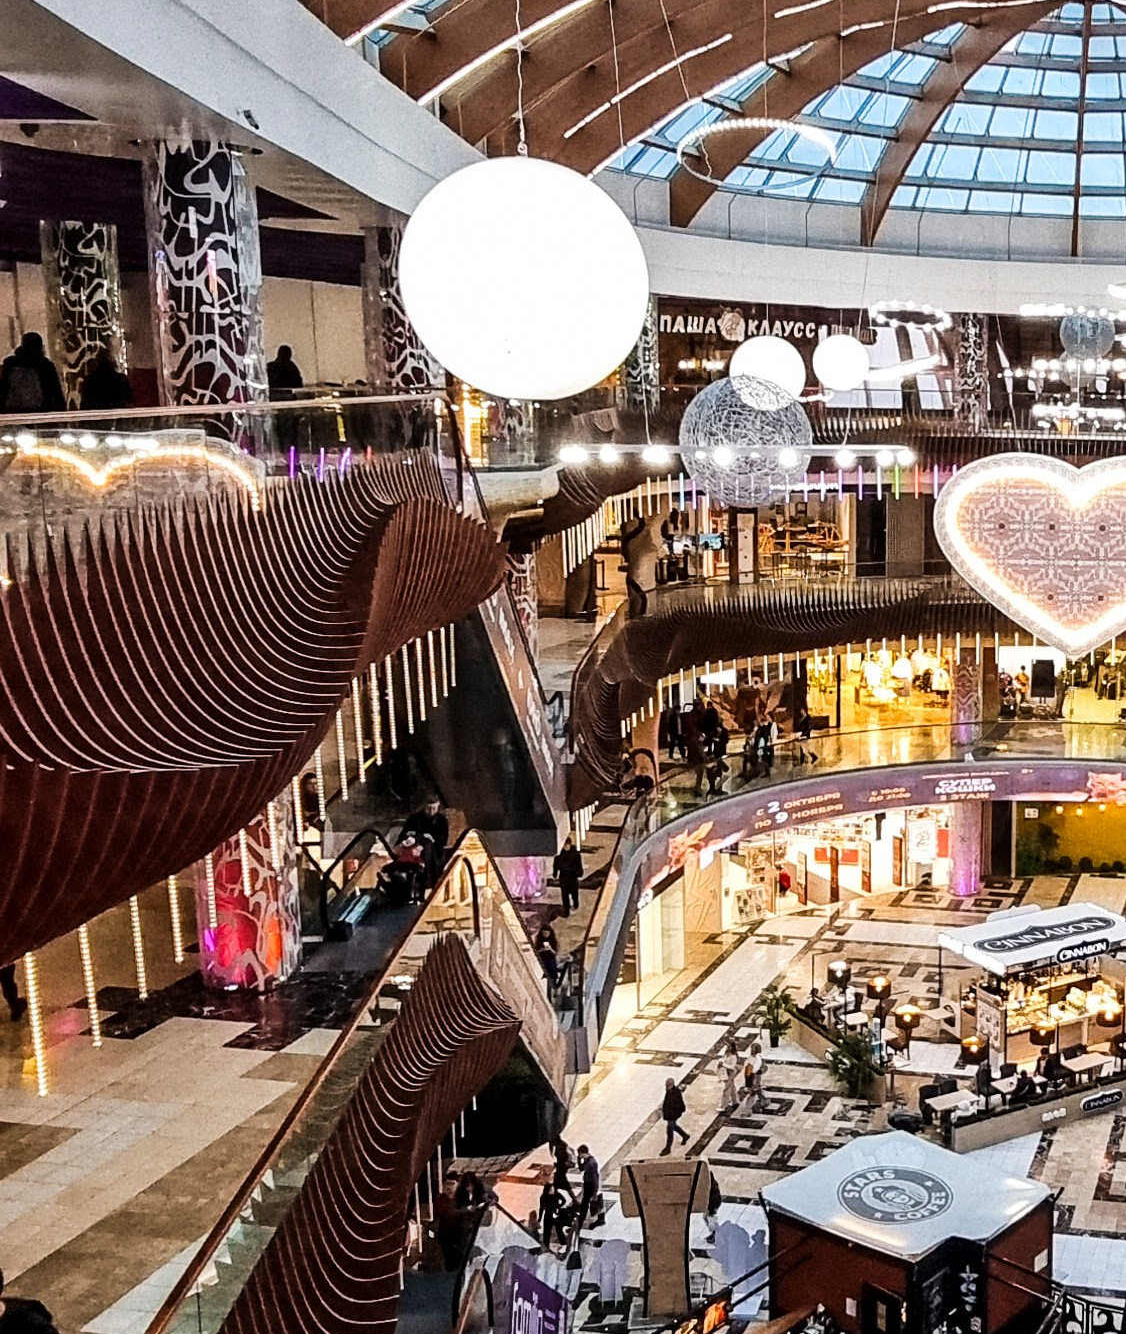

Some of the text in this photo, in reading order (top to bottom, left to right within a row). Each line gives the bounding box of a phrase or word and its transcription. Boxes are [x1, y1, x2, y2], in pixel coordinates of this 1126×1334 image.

[659, 315, 717, 334] ПАША
[747, 319, 816, 338] КЛАУСС
[935, 784, 996, 794] КОШКИ
[938, 777, 993, 787] СУПЕР
[768, 801, 780, 813] 2
[783, 792, 841, 809] ОКТЯБРЯ
[754, 803, 844, 829] ПО 9 НОЯБРЯ
[984, 918, 1105, 952] CINNABON
[1059, 941, 1107, 960] CINNABON
[843, 1169, 946, 1221] STARS COFFEE
